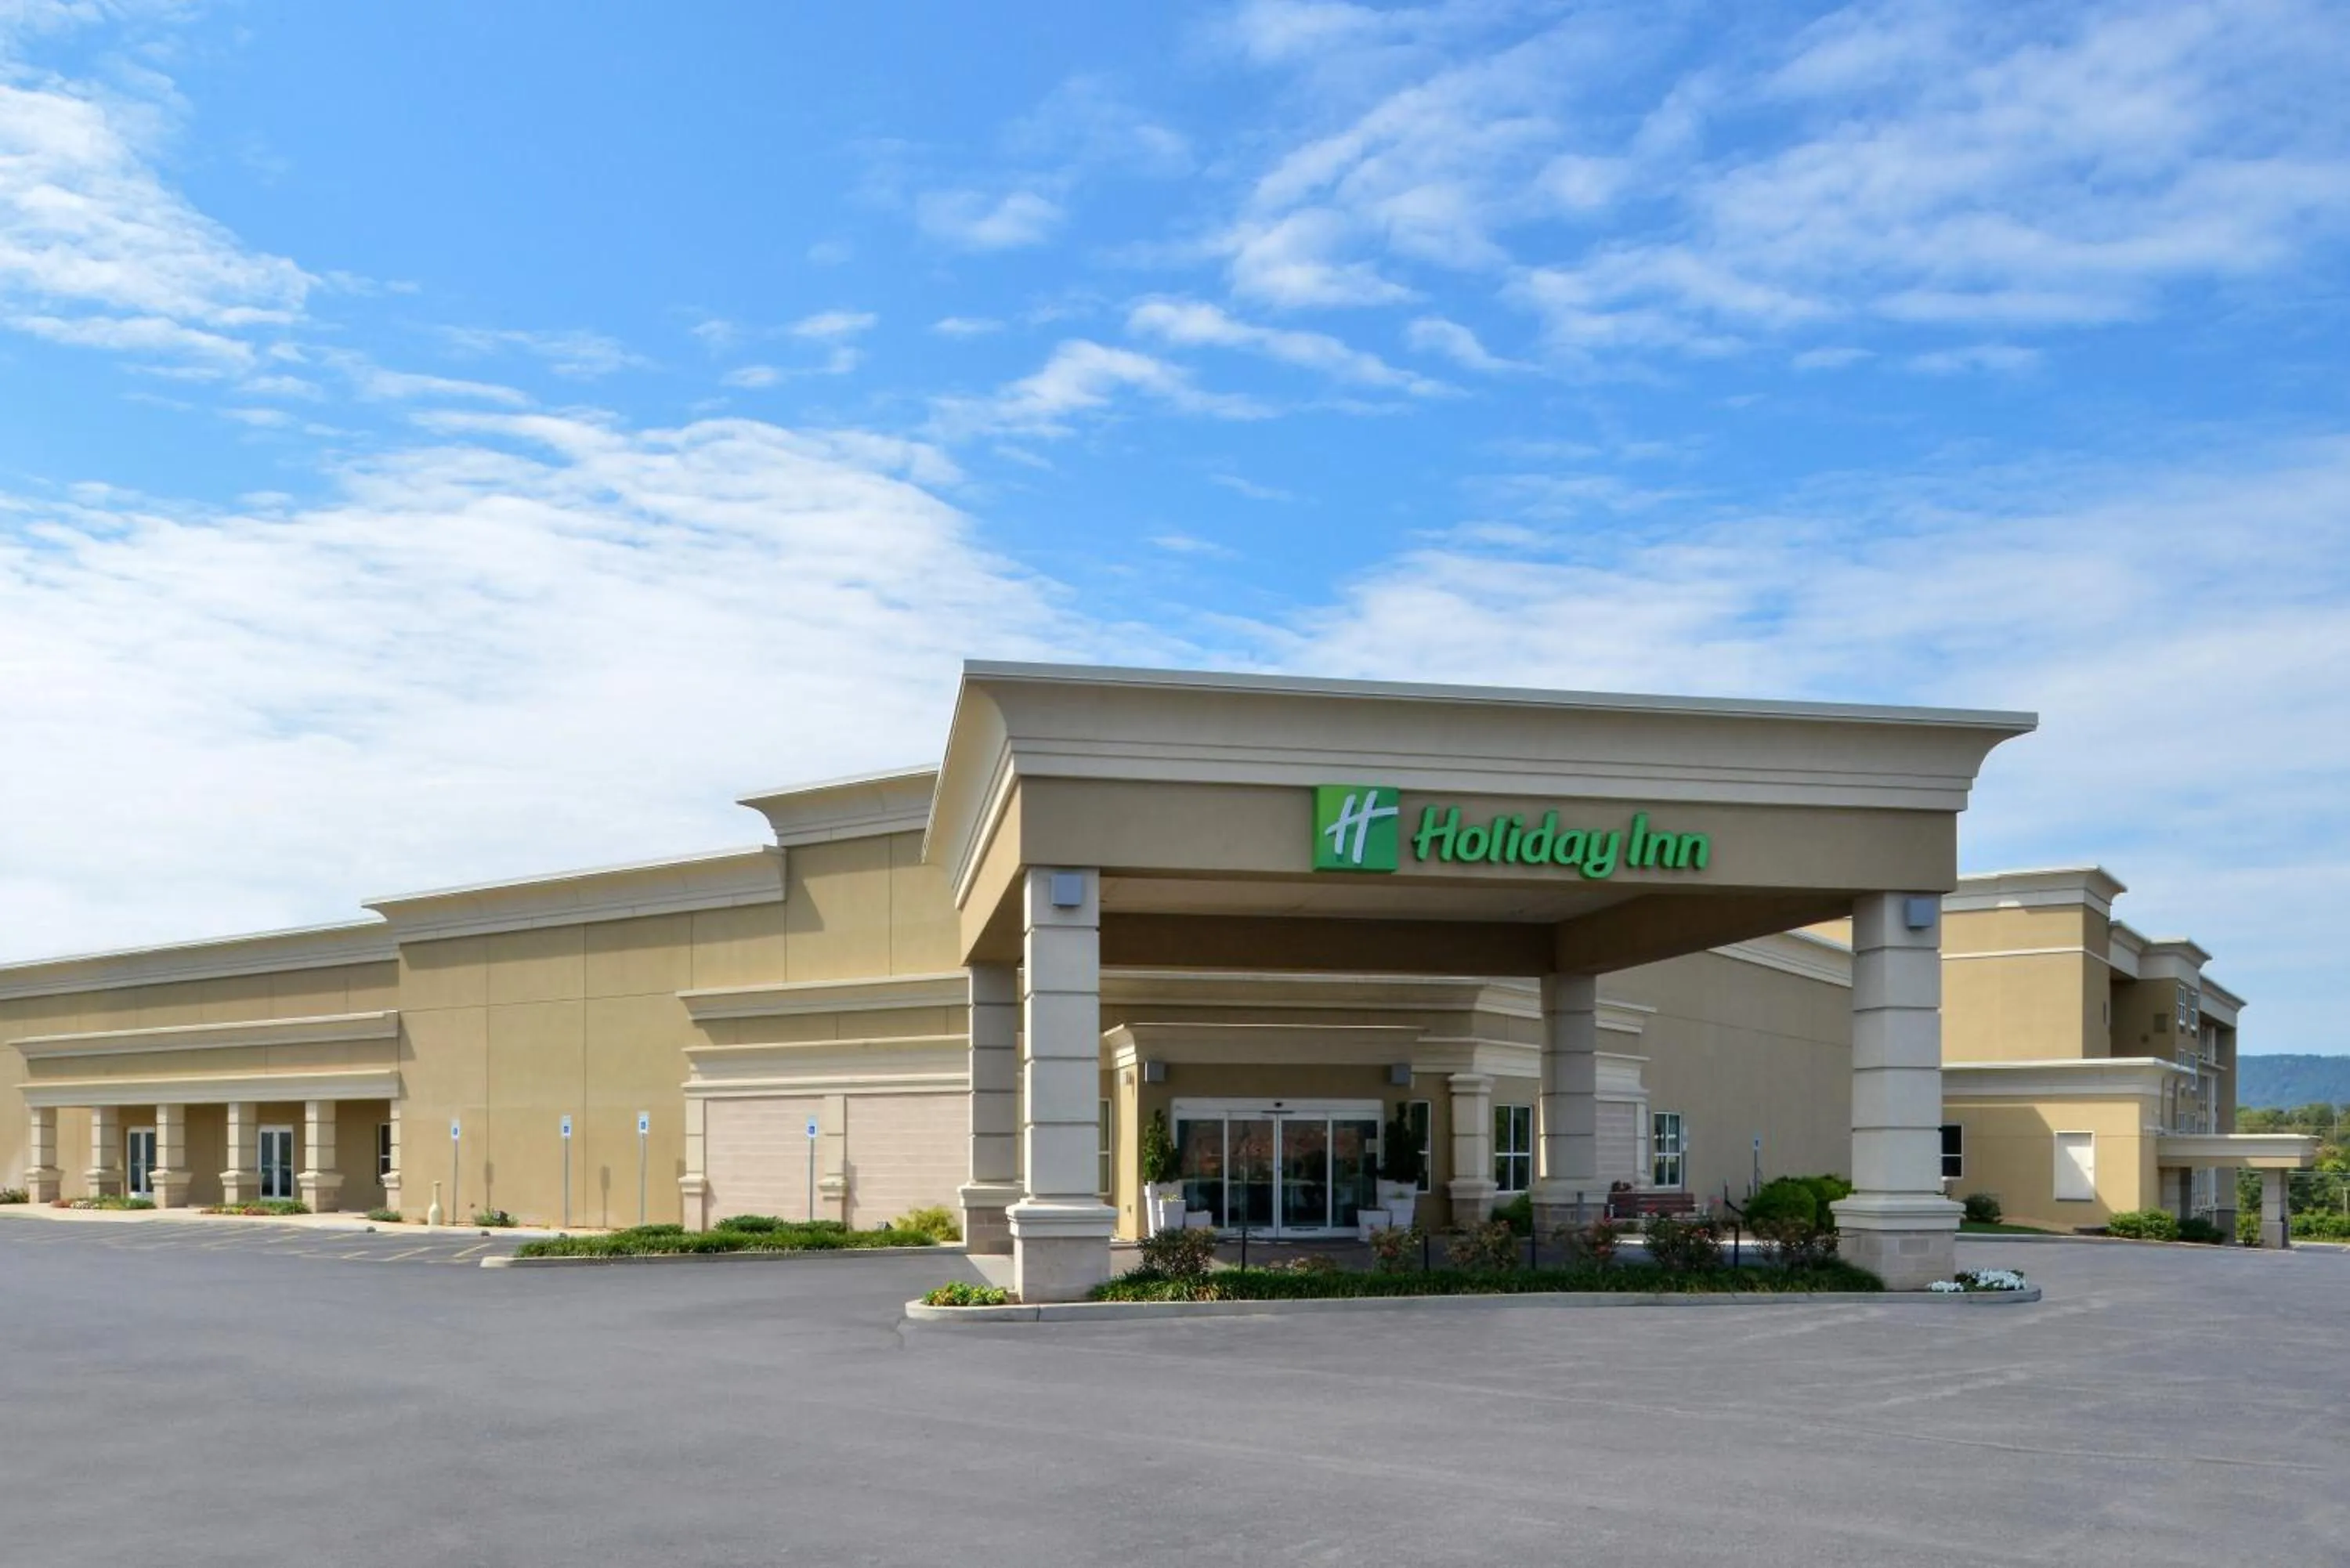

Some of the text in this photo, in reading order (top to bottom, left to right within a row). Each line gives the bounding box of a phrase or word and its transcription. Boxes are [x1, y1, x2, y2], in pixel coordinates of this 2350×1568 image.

[1325, 790, 1398, 863] H
[1412, 805, 1708, 879] Holiday Inn
